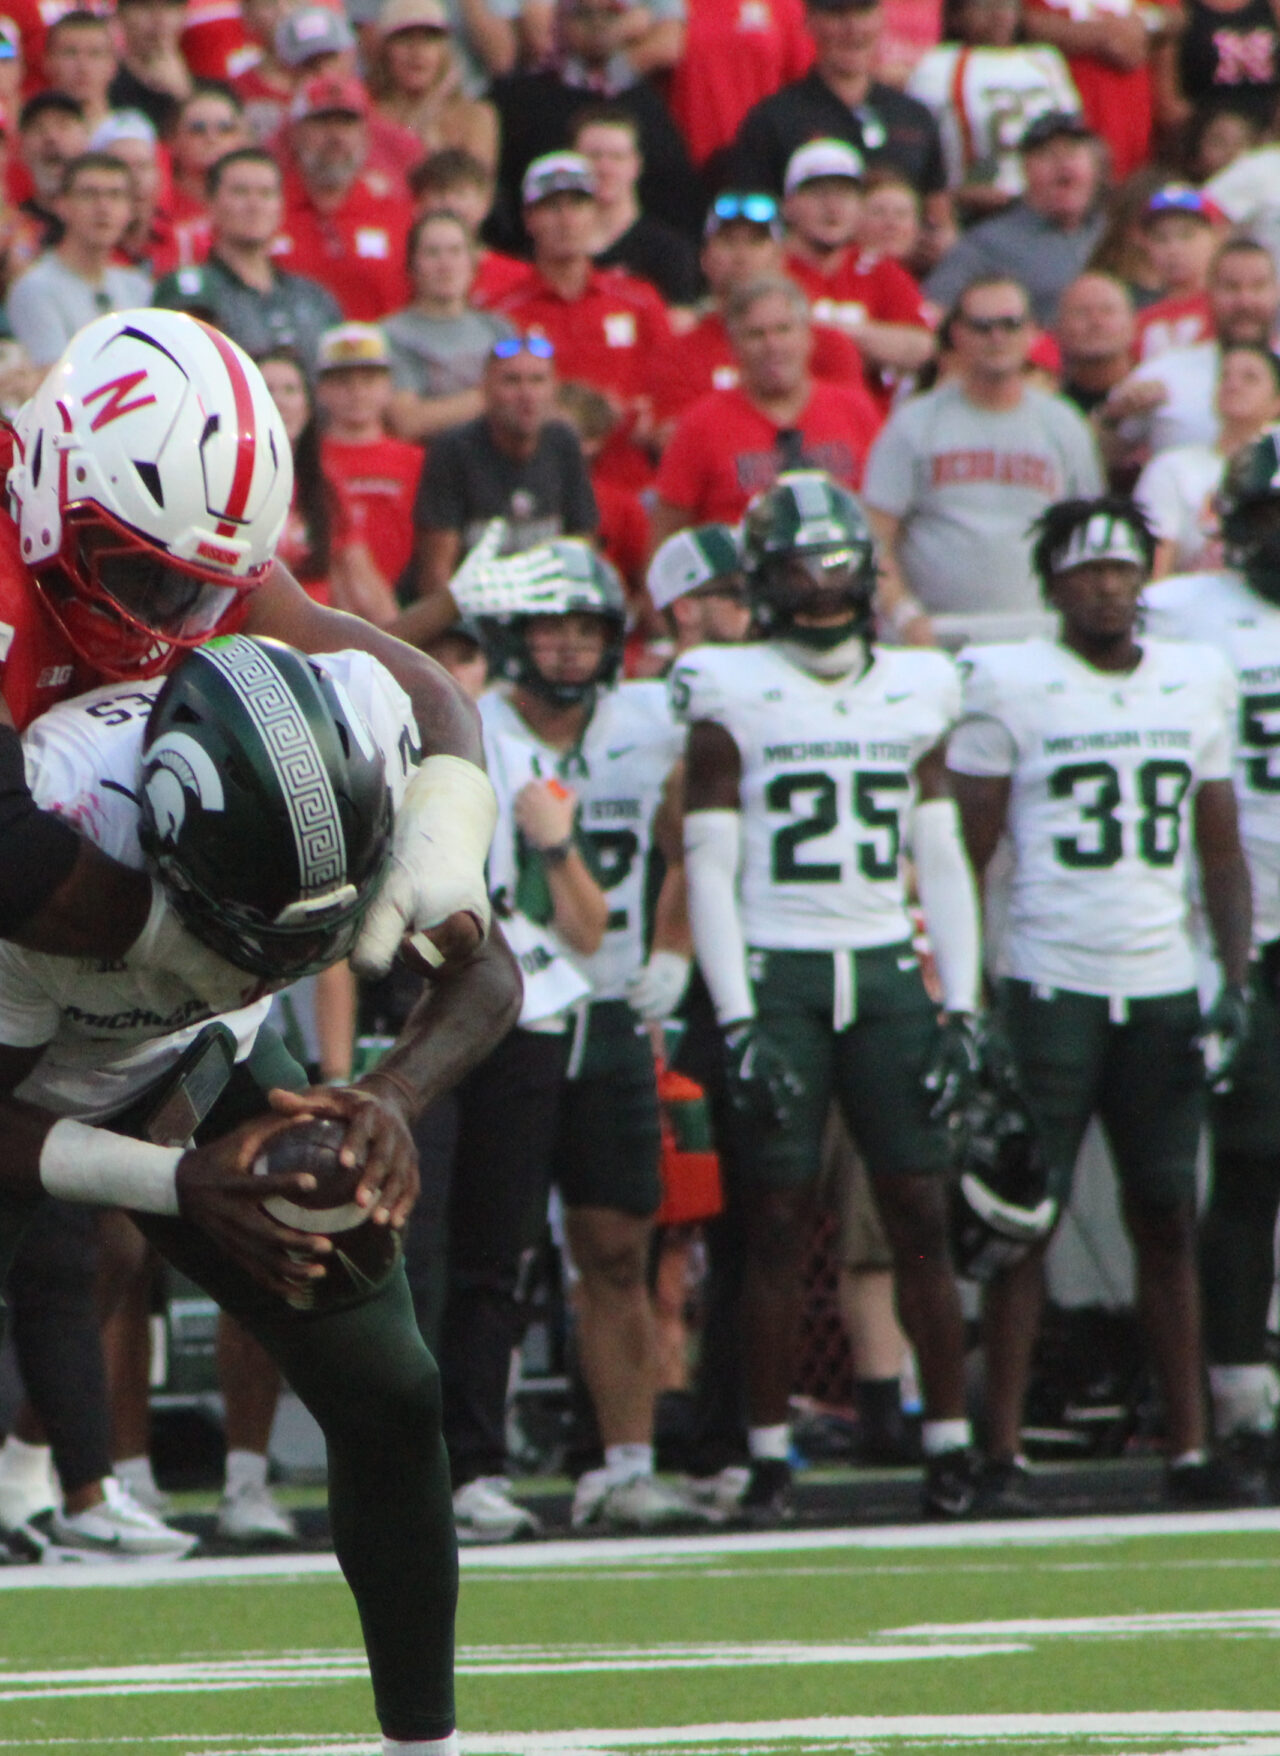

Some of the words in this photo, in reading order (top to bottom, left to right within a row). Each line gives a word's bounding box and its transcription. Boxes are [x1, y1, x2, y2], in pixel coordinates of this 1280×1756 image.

[82, 369, 157, 432] N
[764, 742, 859, 762] MICHIGAN
[1044, 731, 1140, 755] MICHIGAN
[766, 772, 909, 881] 25
[1049, 760, 1191, 868] 38
